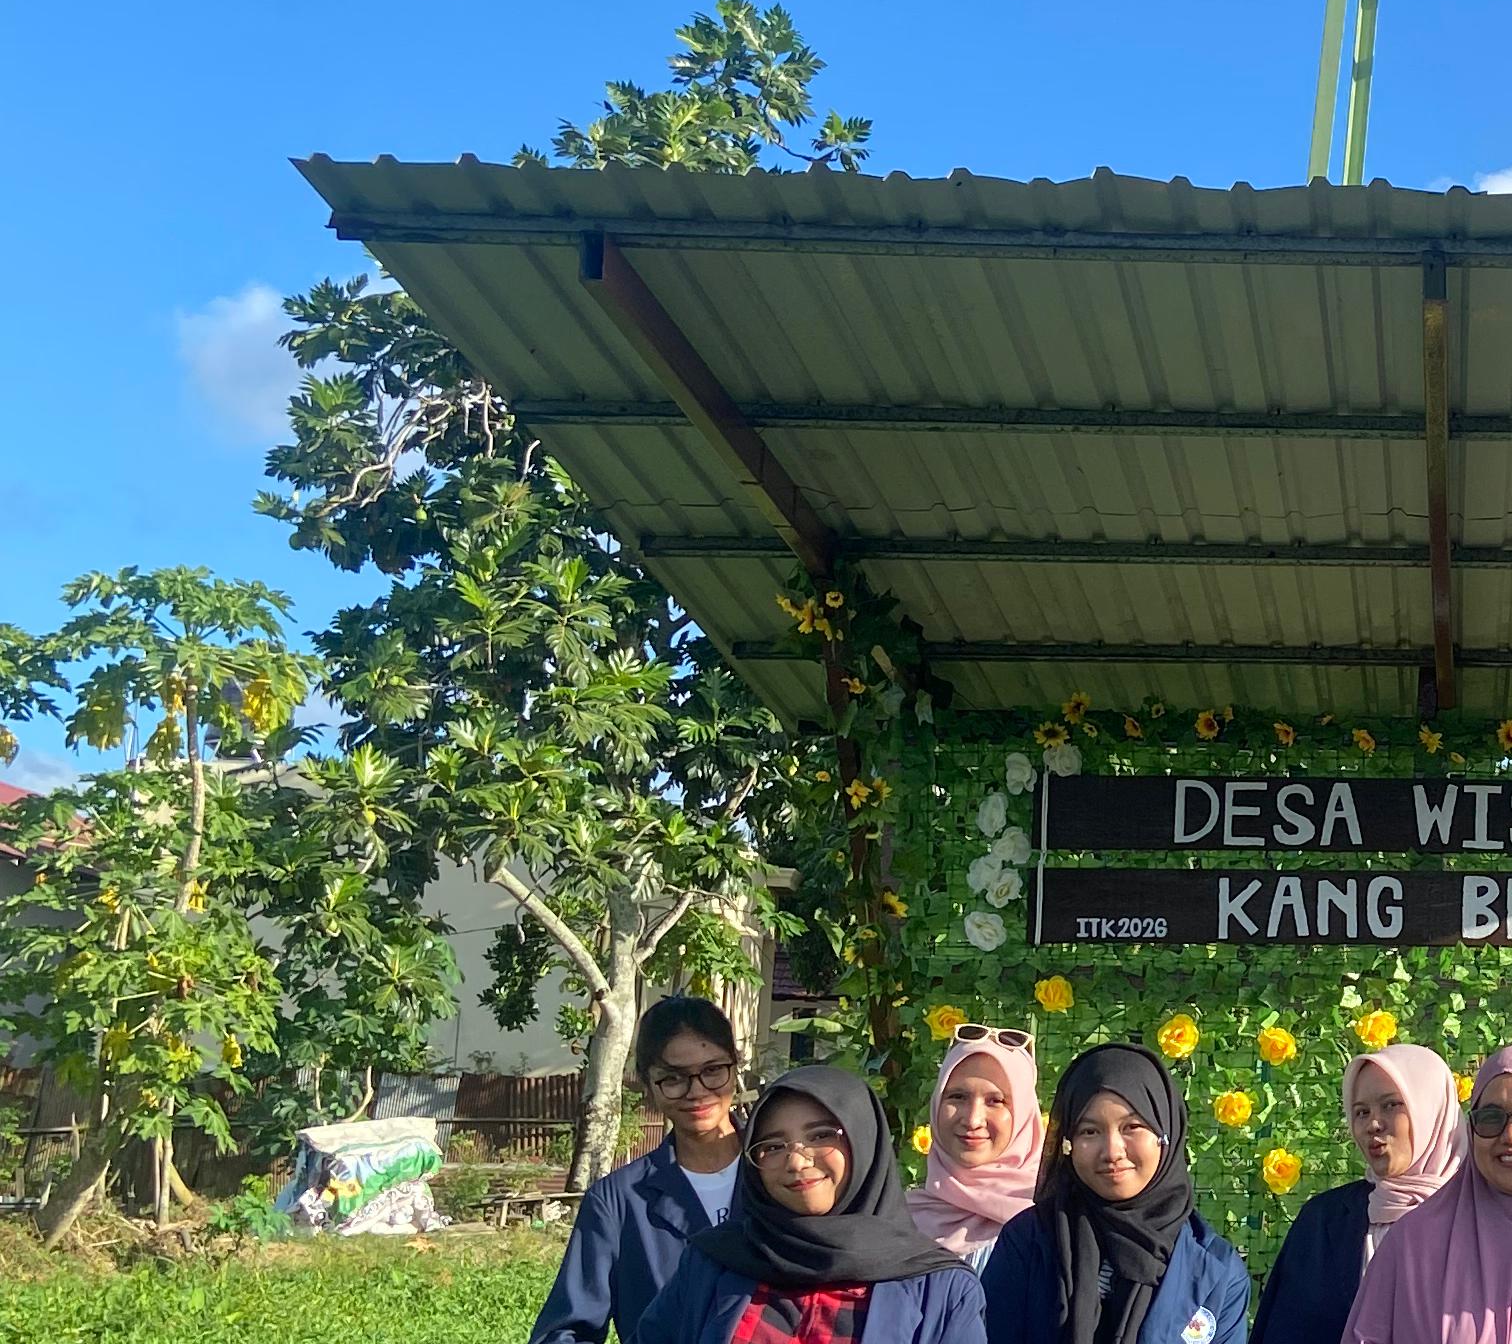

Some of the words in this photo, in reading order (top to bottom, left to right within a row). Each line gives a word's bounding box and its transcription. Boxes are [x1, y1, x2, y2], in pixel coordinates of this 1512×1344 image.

[1174, 779, 1363, 846] DESA
[1076, 917, 1168, 938] ITK2026
[1218, 875, 1404, 940] KANG
